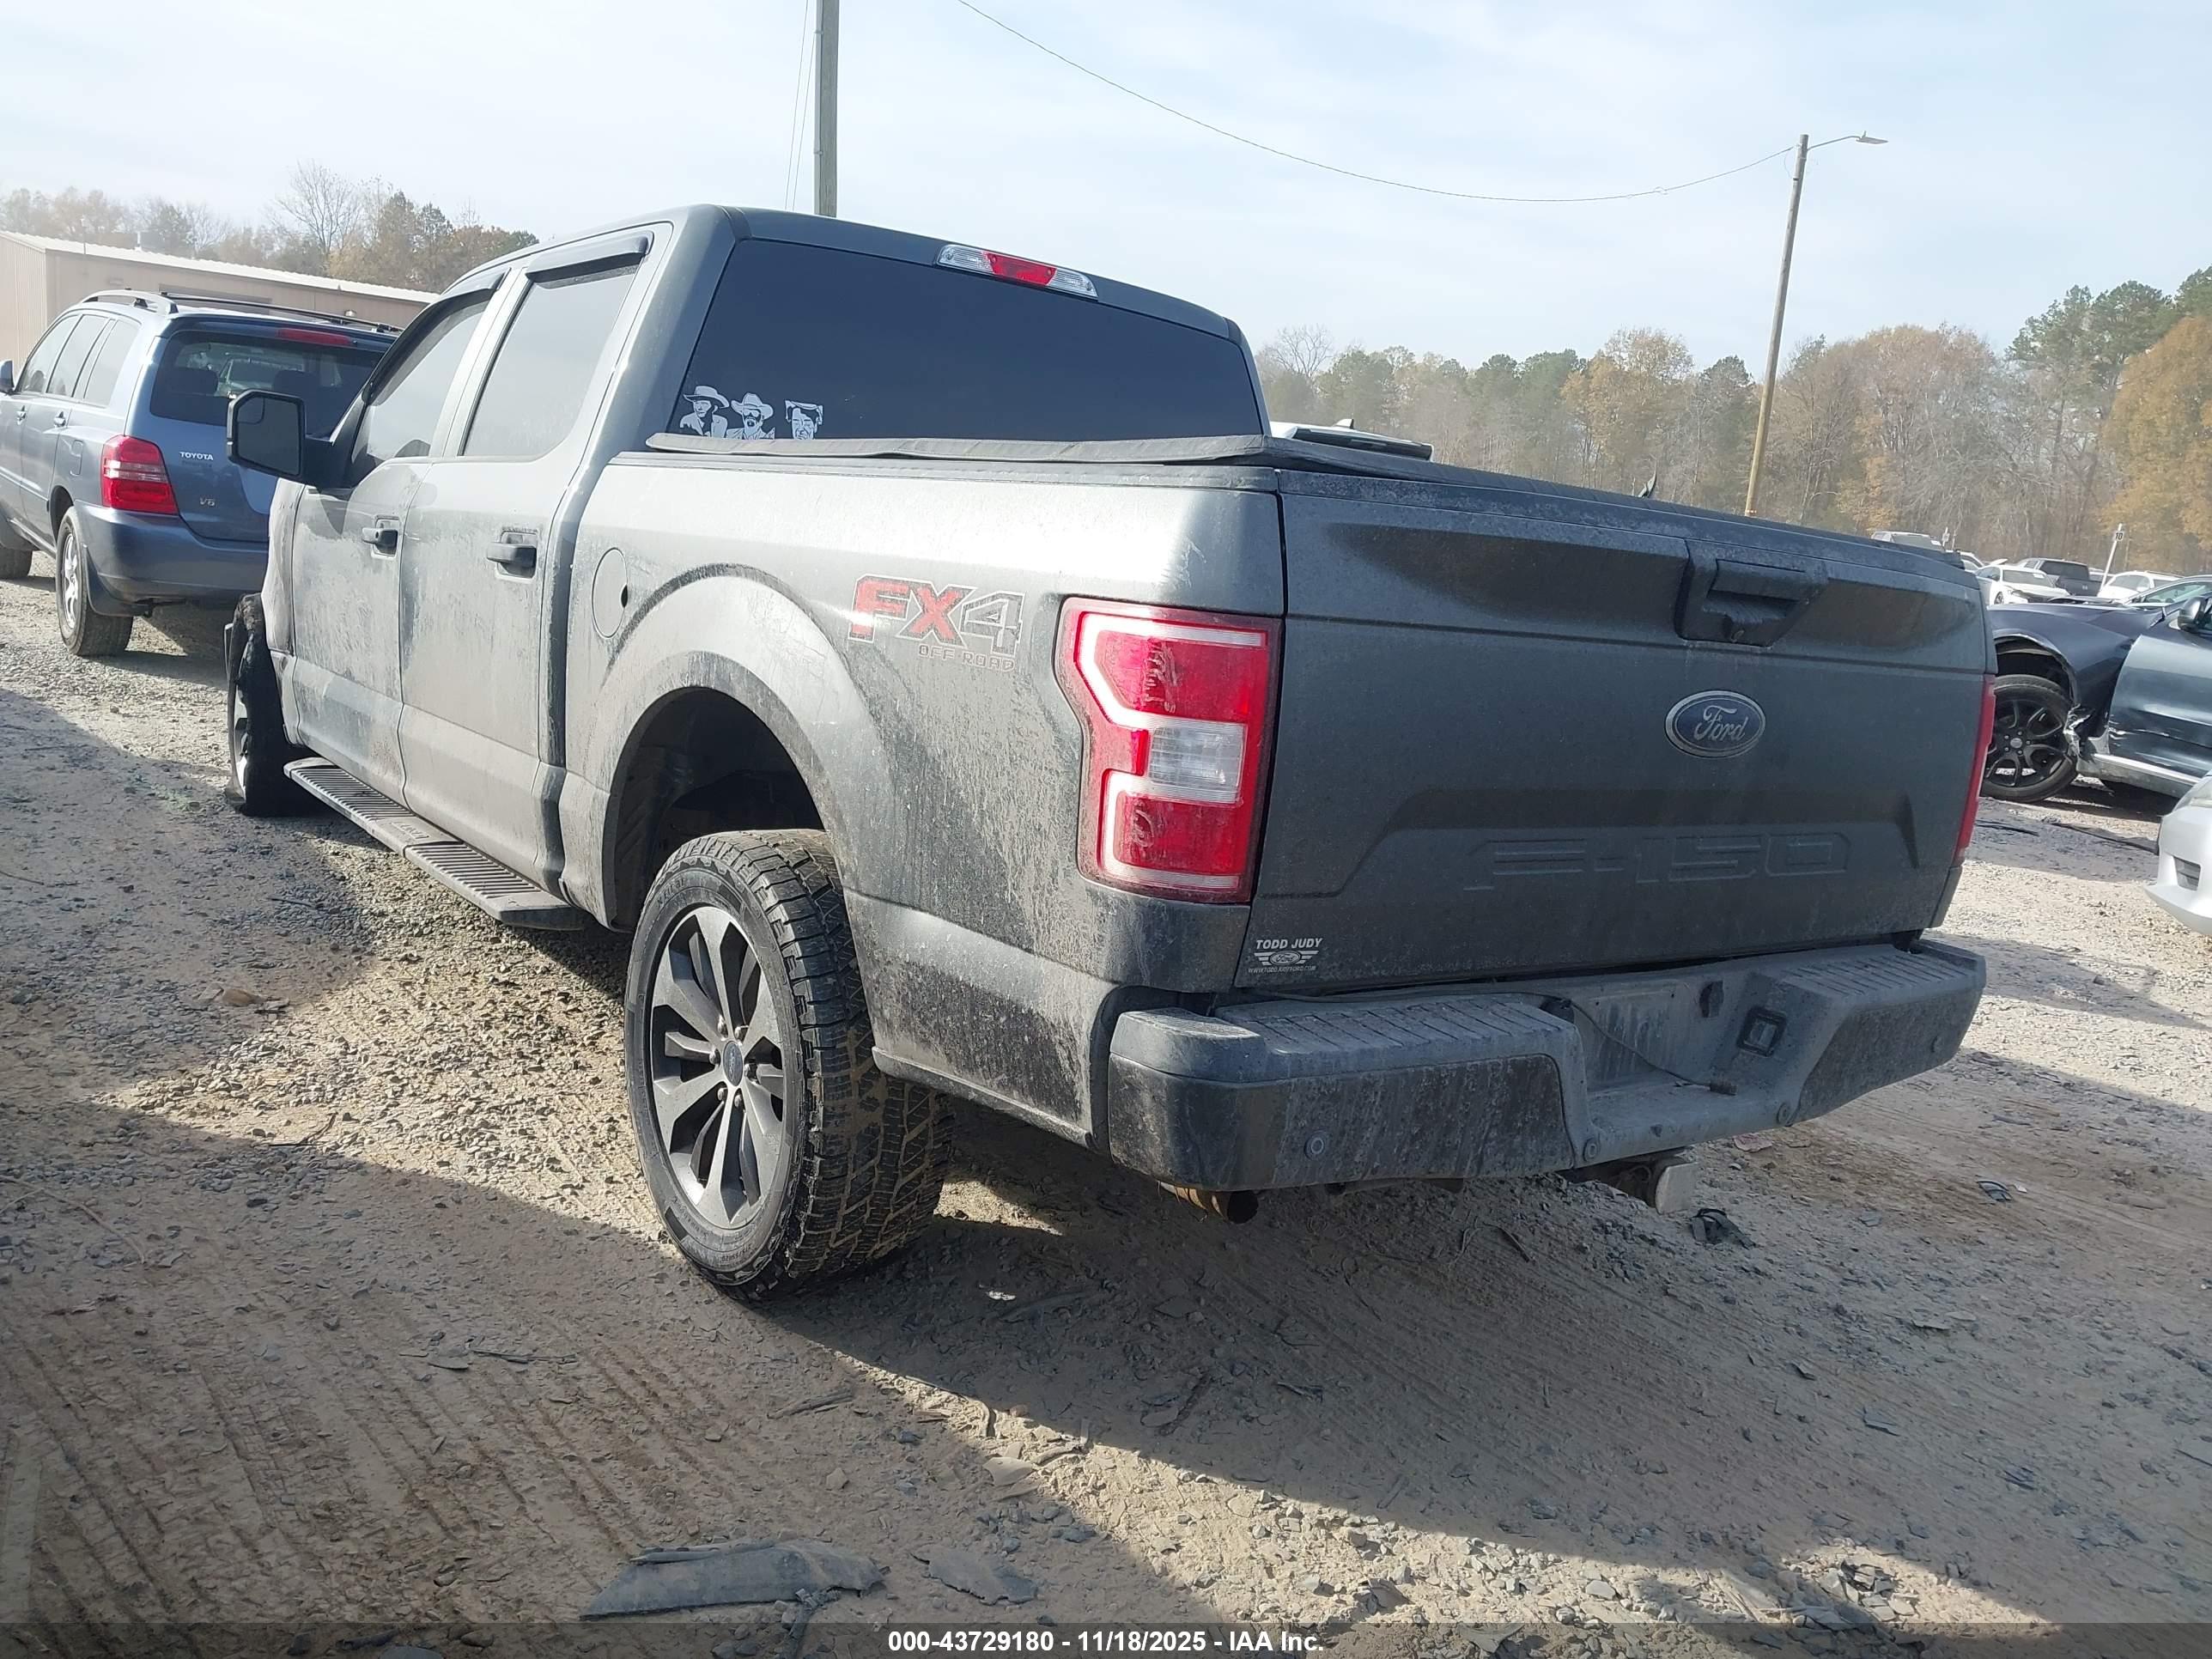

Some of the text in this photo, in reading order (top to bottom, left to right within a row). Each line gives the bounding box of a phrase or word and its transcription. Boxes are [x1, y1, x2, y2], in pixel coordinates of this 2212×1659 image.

[179, 452, 214, 460] TOYOTA
[200, 498, 215, 507] V6
[848, 574, 1025, 657] FX4
[919, 645, 1015, 672] OFF ROAD
[1693, 705, 1749, 741] Ford
[1255, 938, 1323, 950] TODD JUDY
